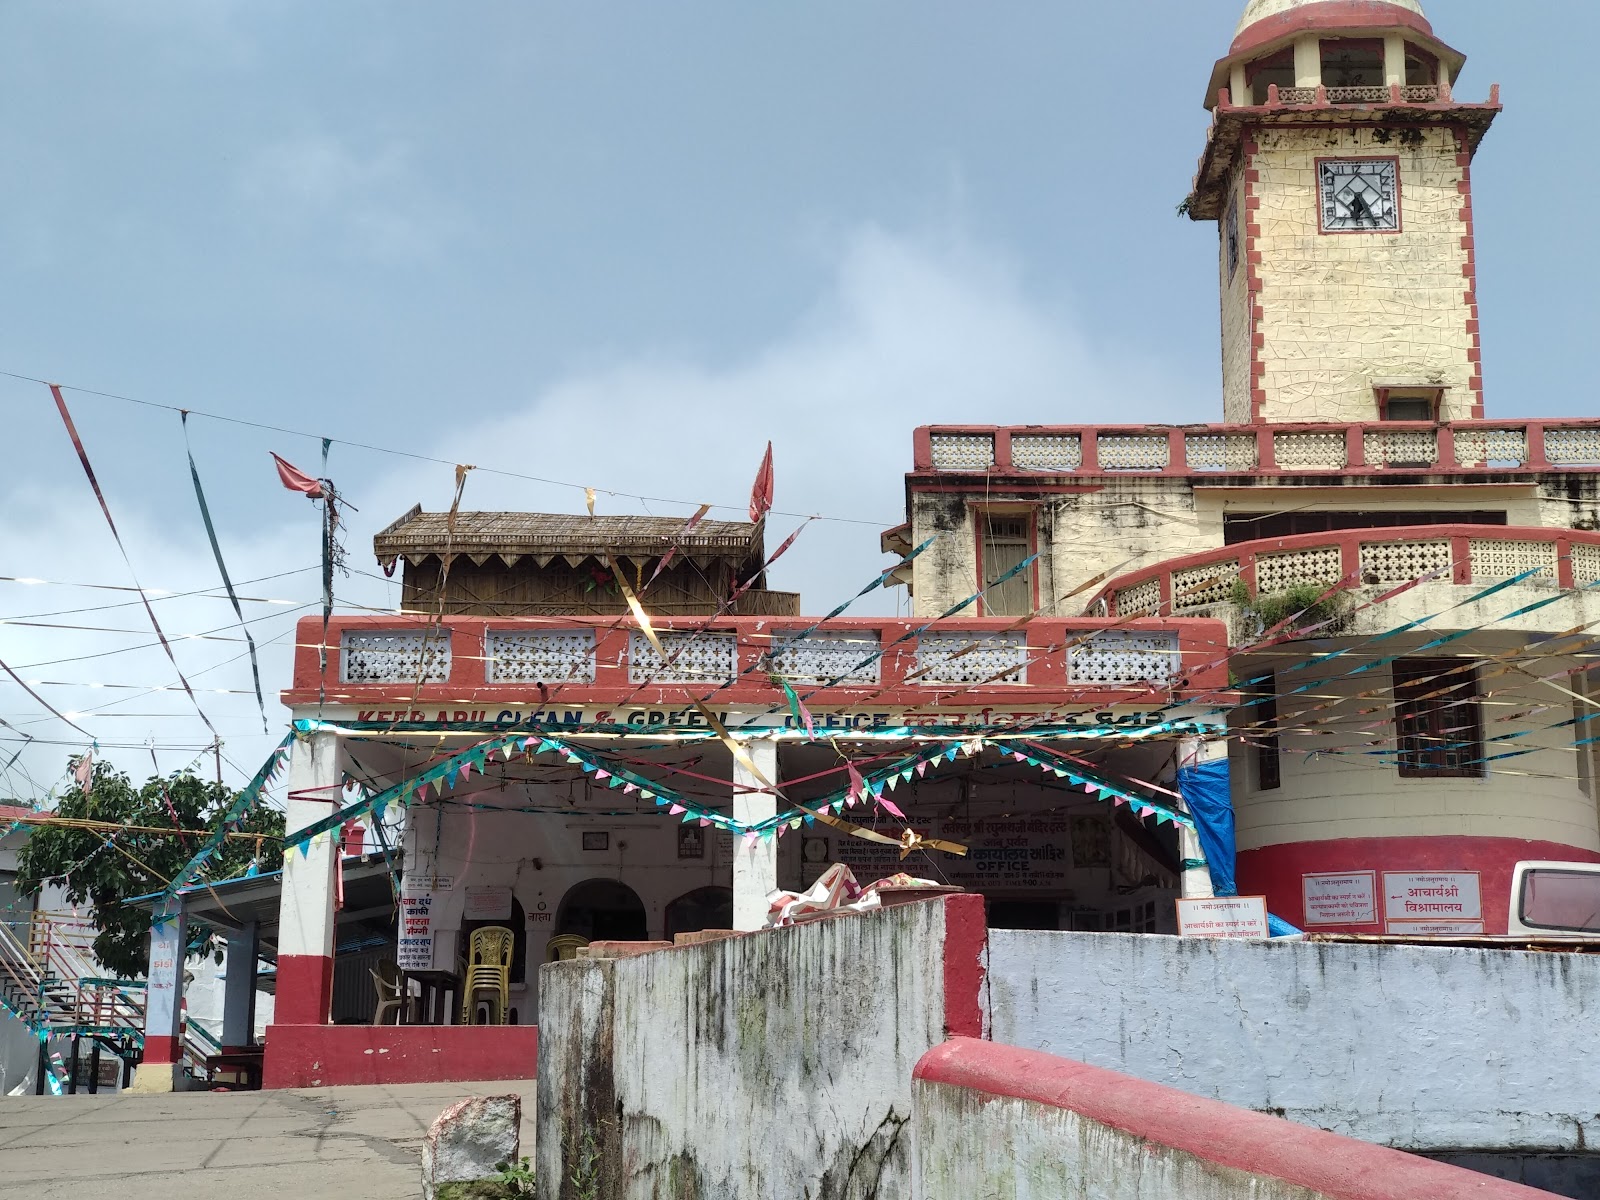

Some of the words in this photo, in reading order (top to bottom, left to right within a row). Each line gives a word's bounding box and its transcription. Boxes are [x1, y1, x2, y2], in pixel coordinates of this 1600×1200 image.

[496, 710, 583, 723] CLEAN
[628, 711, 728, 725] GREEN
[976, 861, 1029, 871] OFFICE
[1407, 884, 1459, 898] आचार्यश्री
[1405, 900, 1463, 913] विश्रामालय
[1184, 921, 1214, 929] आचार्यश्री
